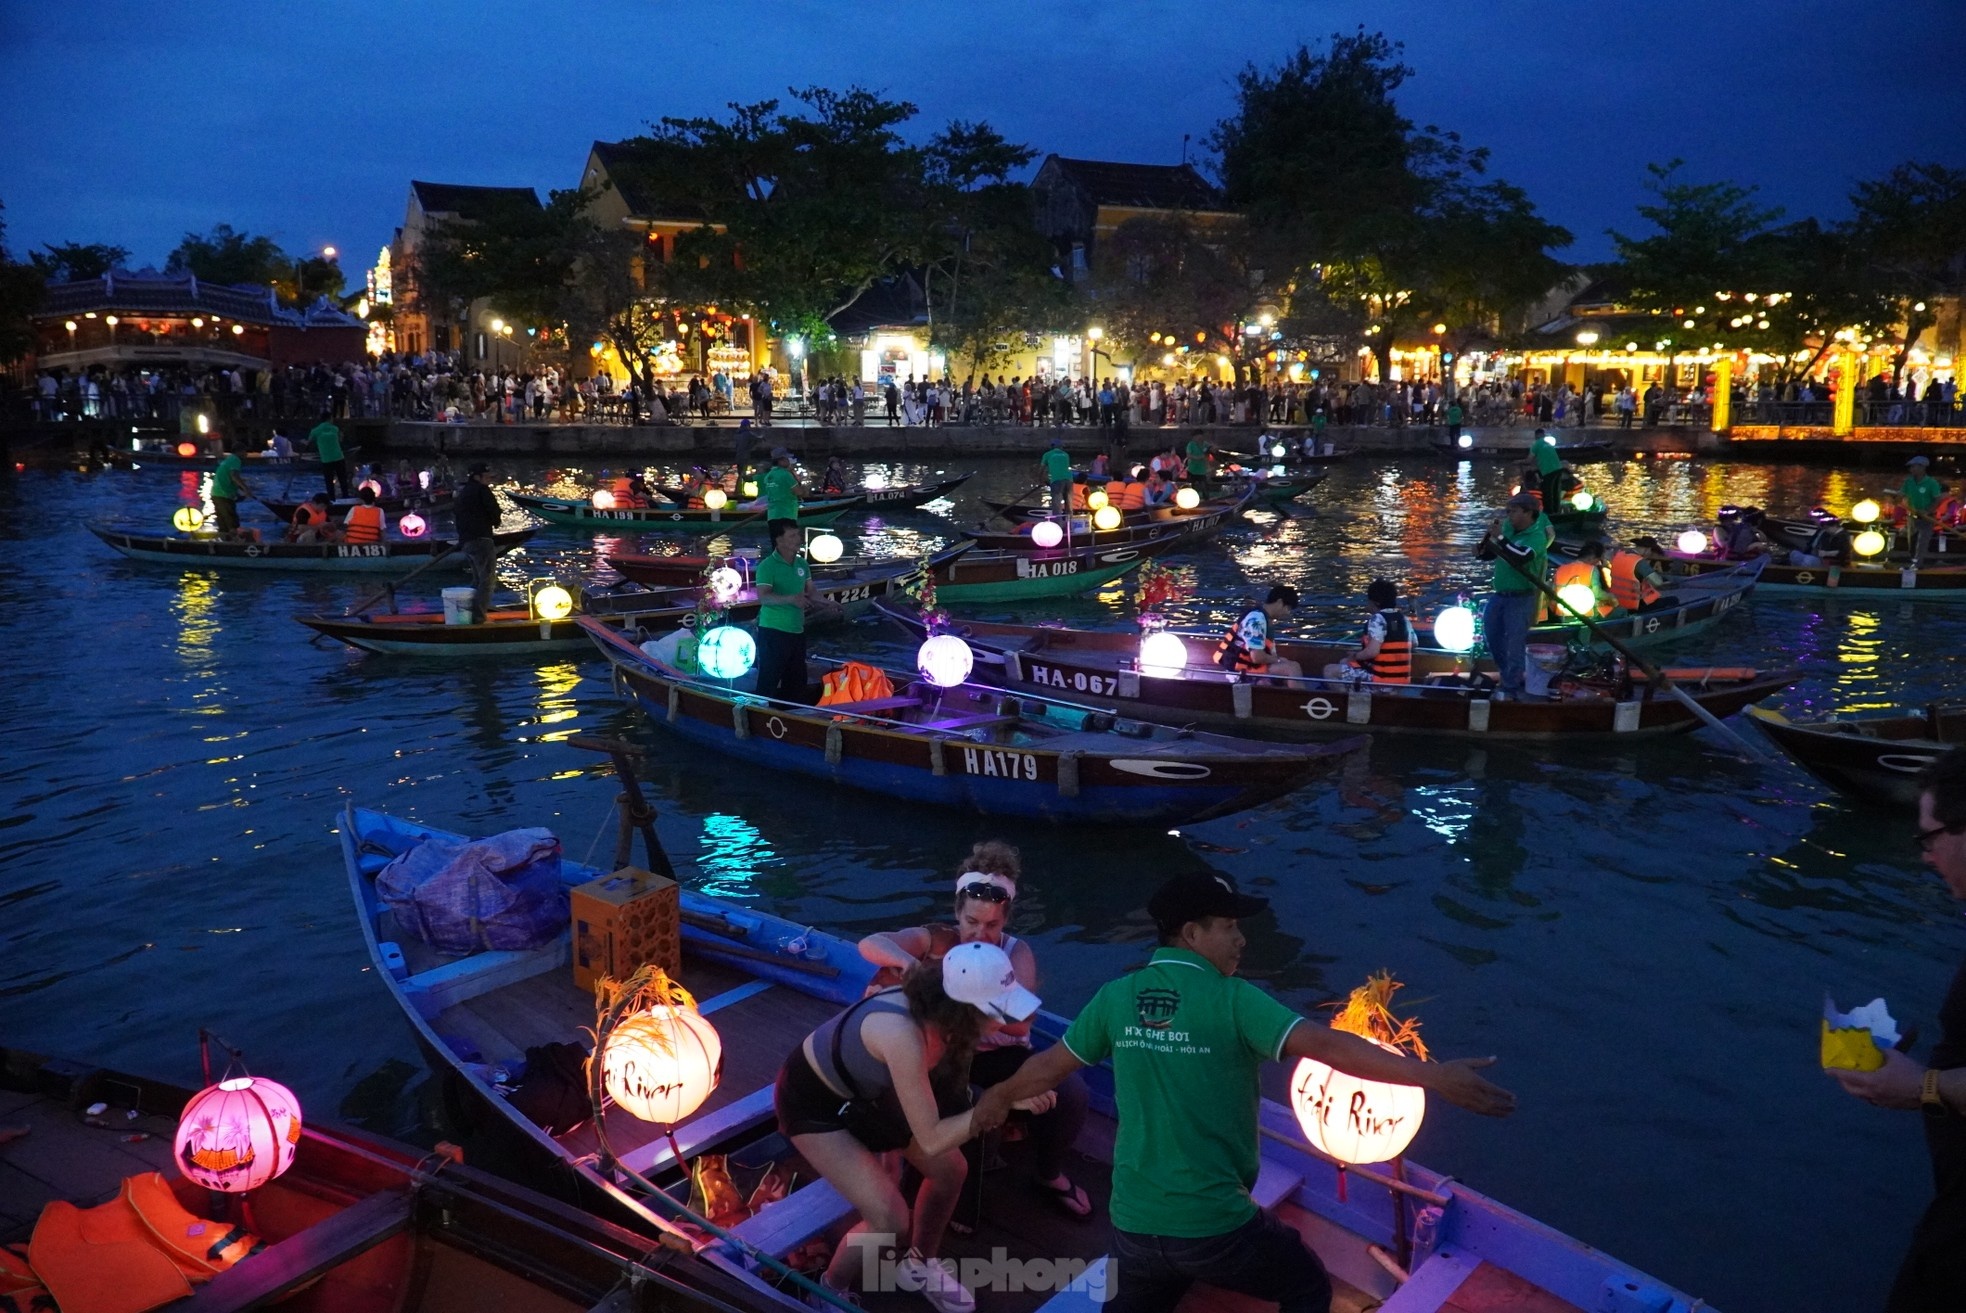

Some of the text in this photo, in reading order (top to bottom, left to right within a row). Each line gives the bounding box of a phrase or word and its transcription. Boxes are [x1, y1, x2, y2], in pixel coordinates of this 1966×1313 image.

[614, 511, 634, 520] 199
[1052, 560, 1078, 576] 018
[840, 585, 870, 605] 224
[1199, 1046, 1211, 1055] AN
